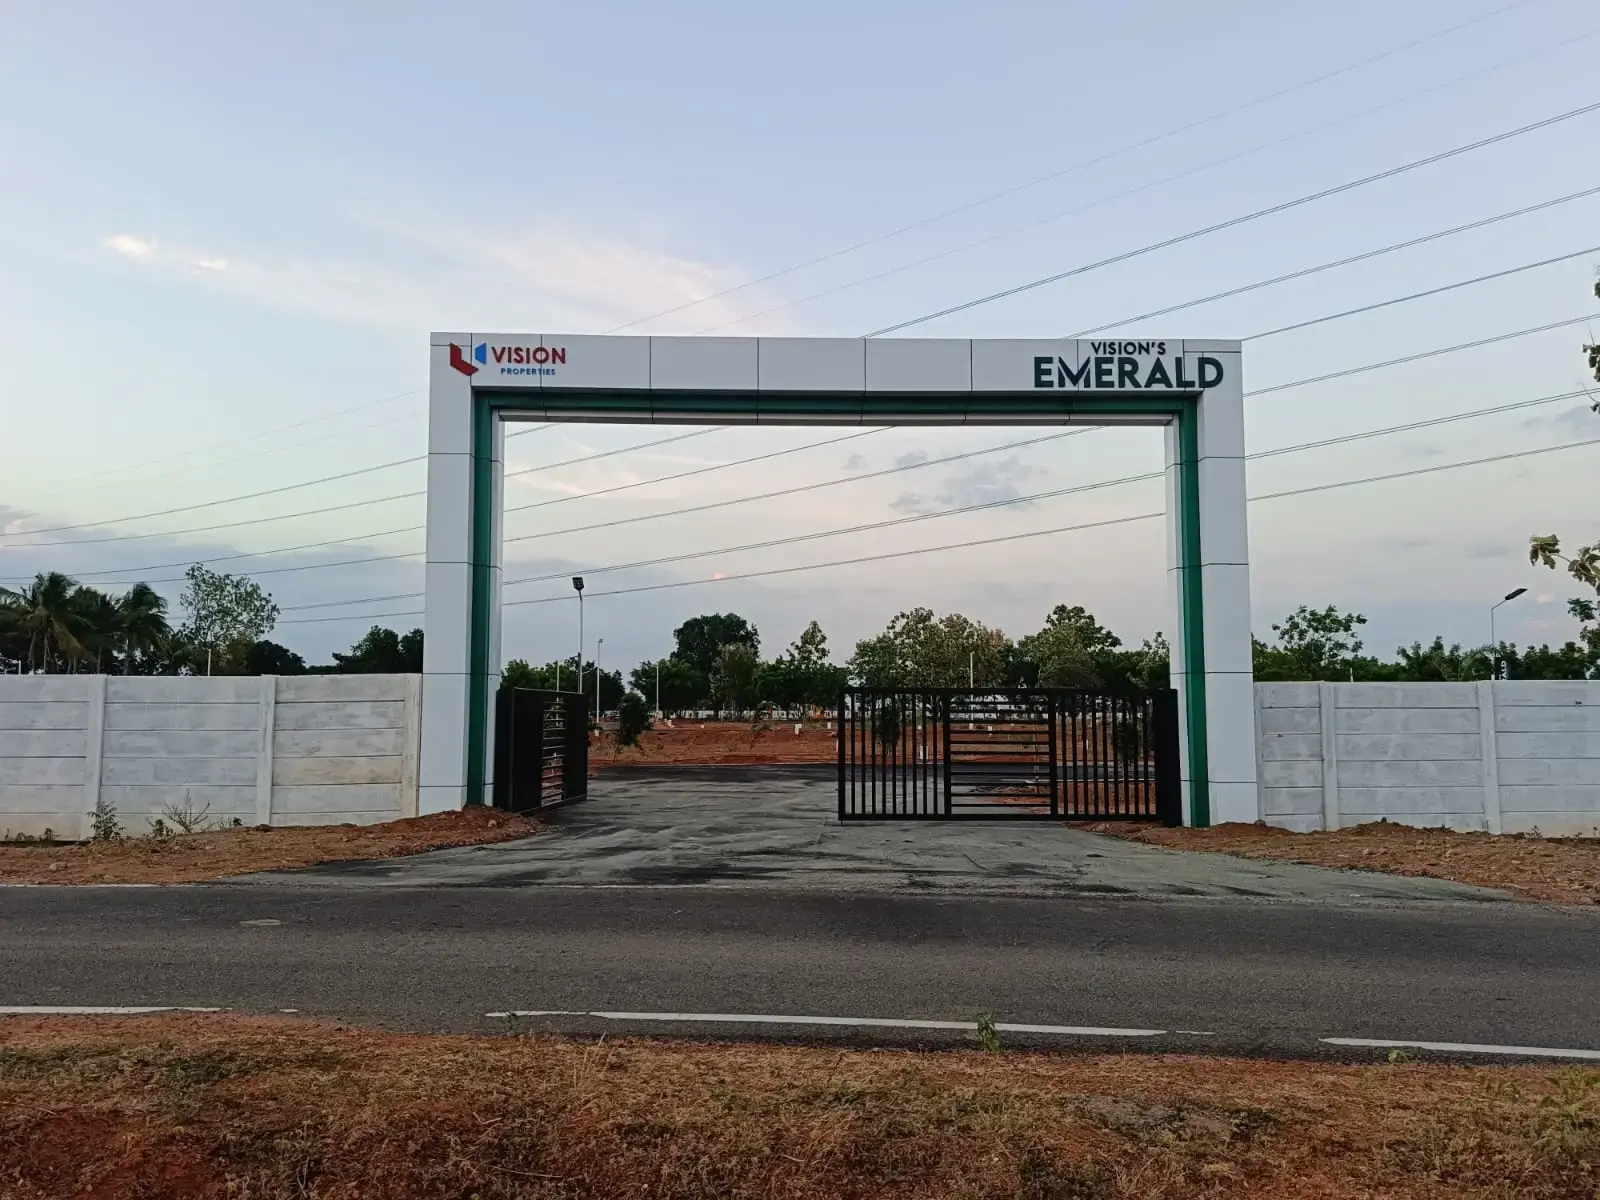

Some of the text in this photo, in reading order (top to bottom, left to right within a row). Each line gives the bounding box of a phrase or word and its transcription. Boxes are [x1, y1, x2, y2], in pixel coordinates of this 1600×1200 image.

[491, 346, 567, 364] VISION
[1091, 341, 1166, 355] VISION'S
[500, 367, 556, 376] PROPERTIES
[1034, 355, 1224, 389] EMERALD
